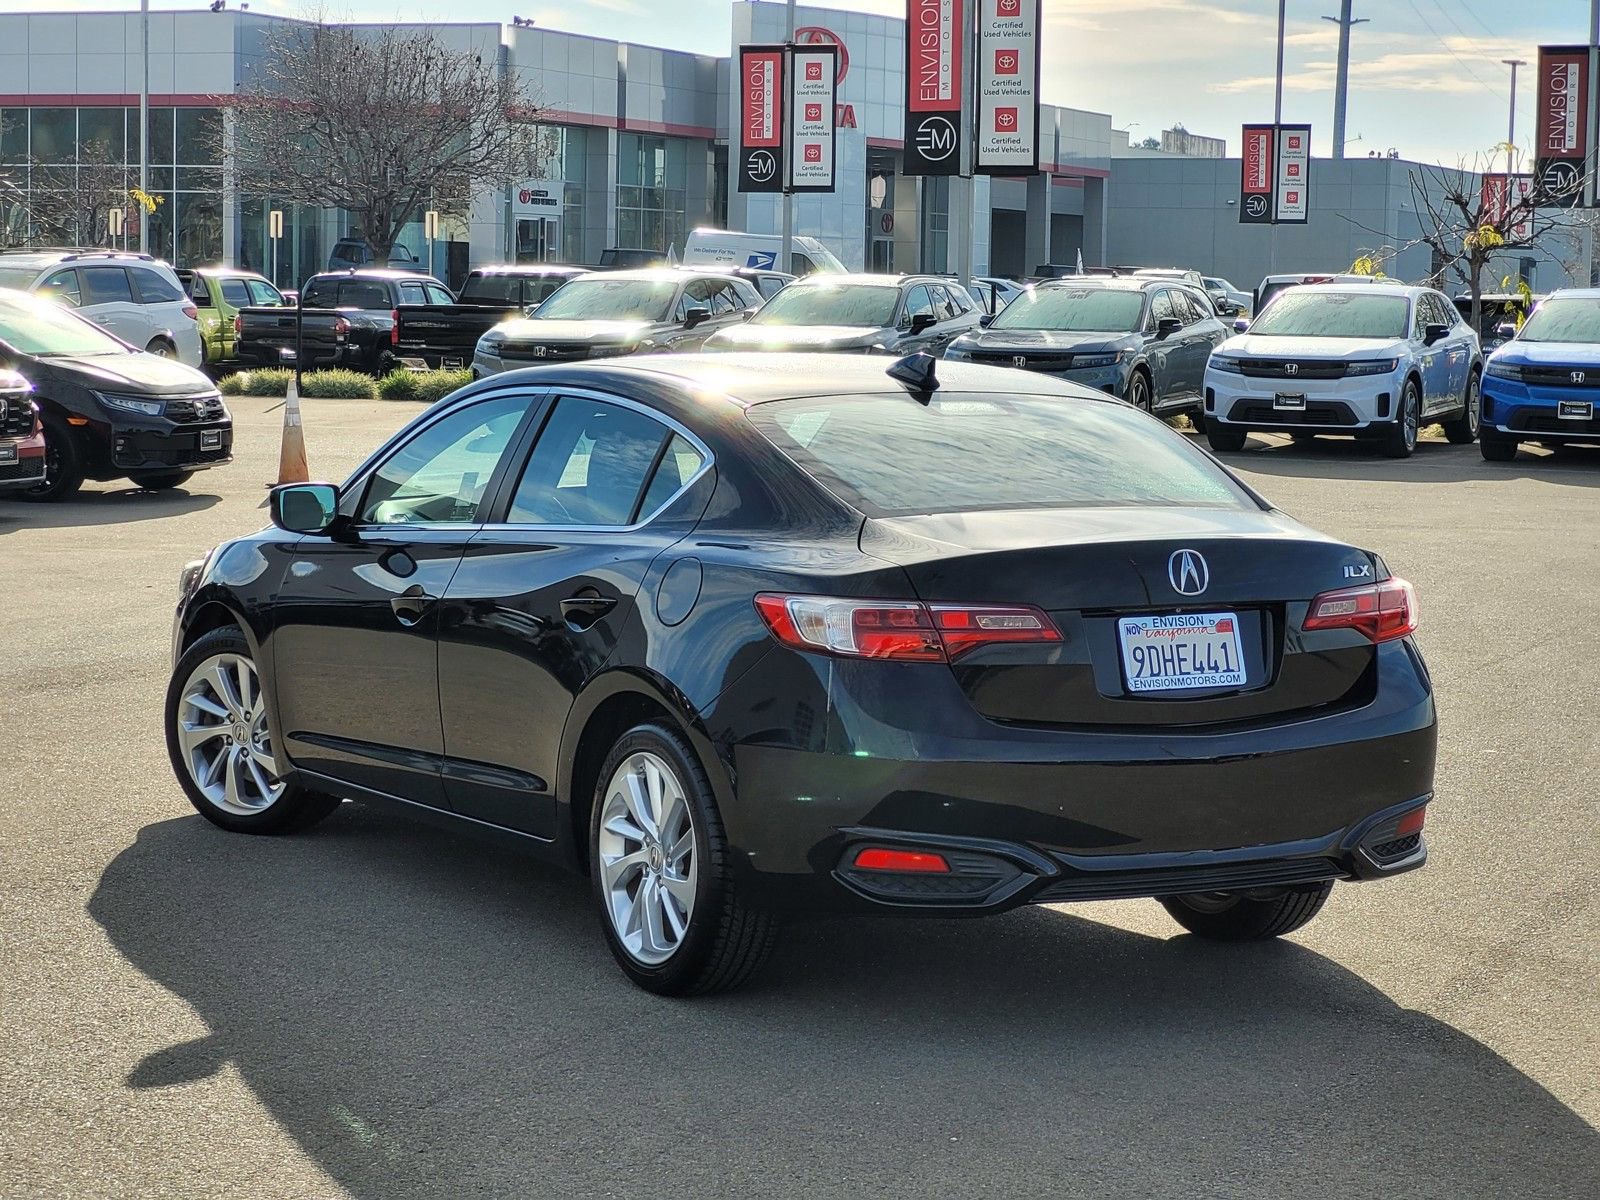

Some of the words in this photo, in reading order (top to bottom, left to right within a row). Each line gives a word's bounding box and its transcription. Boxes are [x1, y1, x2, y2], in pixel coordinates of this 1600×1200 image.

[750, 60, 764, 139] ENVISION
[1548, 63, 1567, 149] ENVISION
[1568, 71, 1577, 142] MOTORS
[1249, 134, 1259, 188] ENVISION
[1344, 565, 1370, 578] ILX
[1126, 625, 1140, 635] NOV
[1152, 616, 1204, 628] ENVISION
[1132, 642, 1240, 678] 9DHE441
[1135, 674, 1240, 689] ENVISIONMOTORS.COM
